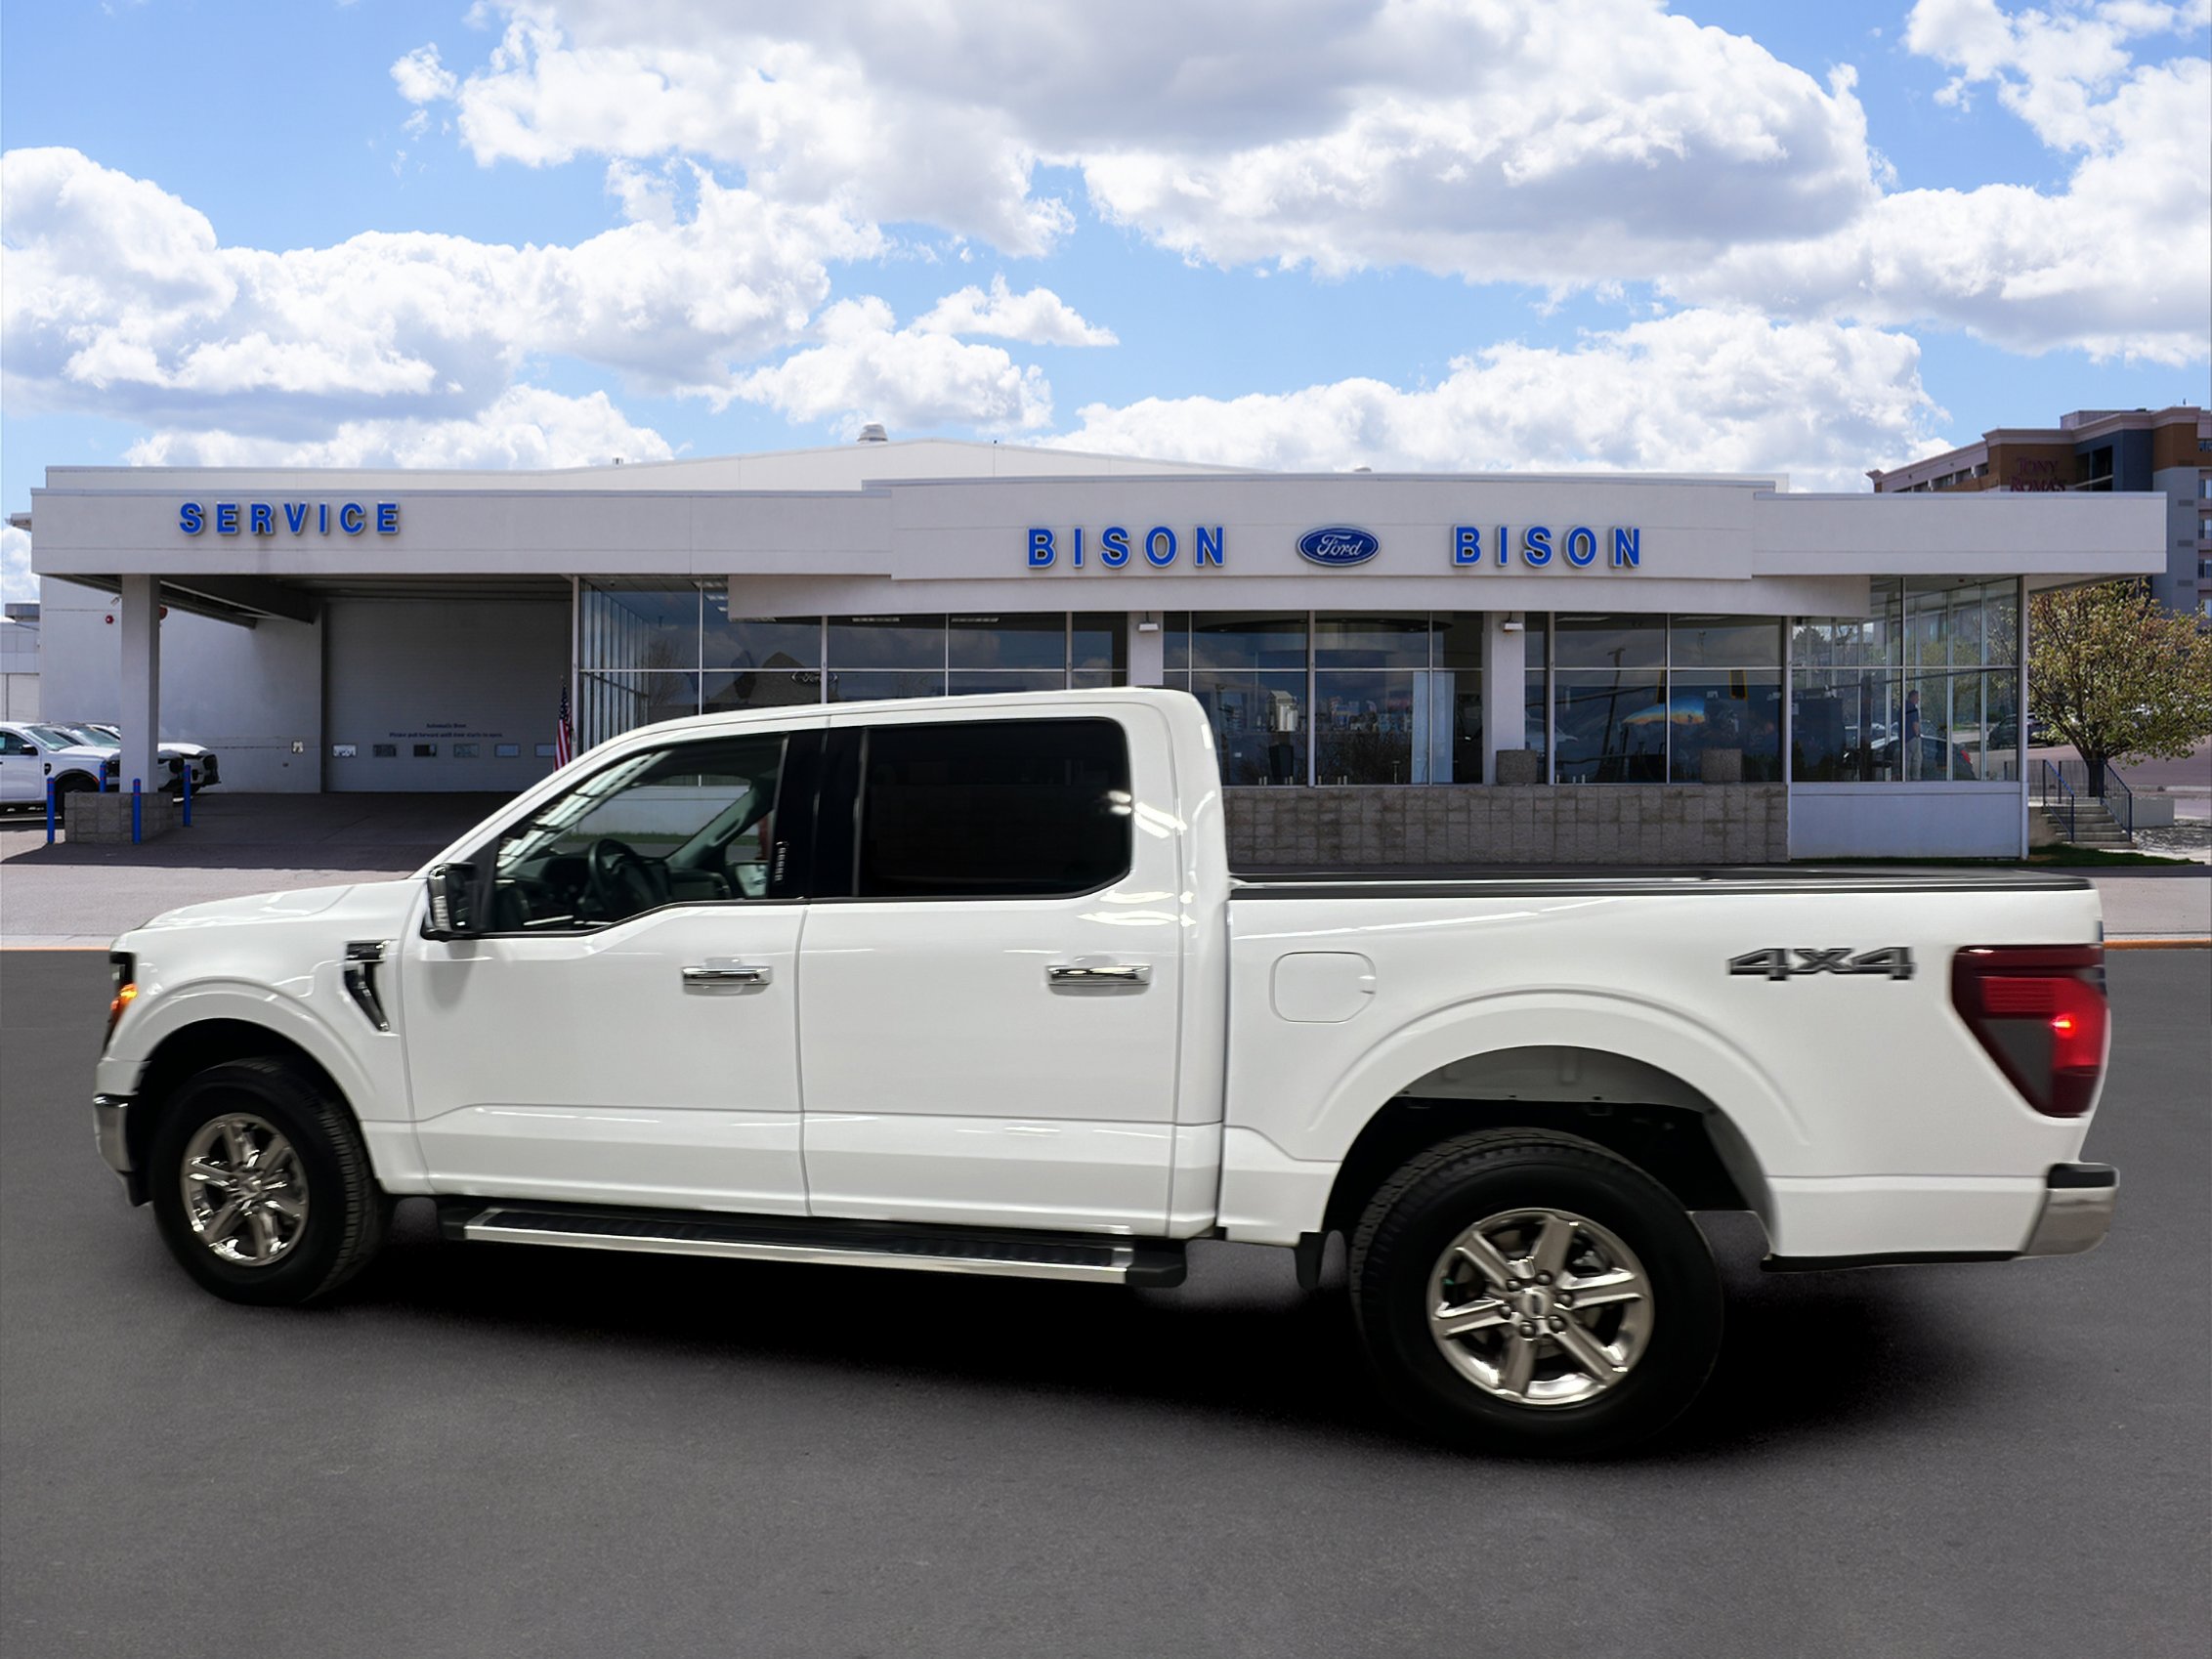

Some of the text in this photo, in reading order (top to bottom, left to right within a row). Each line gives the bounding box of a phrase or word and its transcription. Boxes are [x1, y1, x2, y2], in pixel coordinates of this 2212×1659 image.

[179, 502, 401, 534] SERVICE
[1027, 526, 1225, 568] BISON
[1453, 526, 1640, 568] BISON
